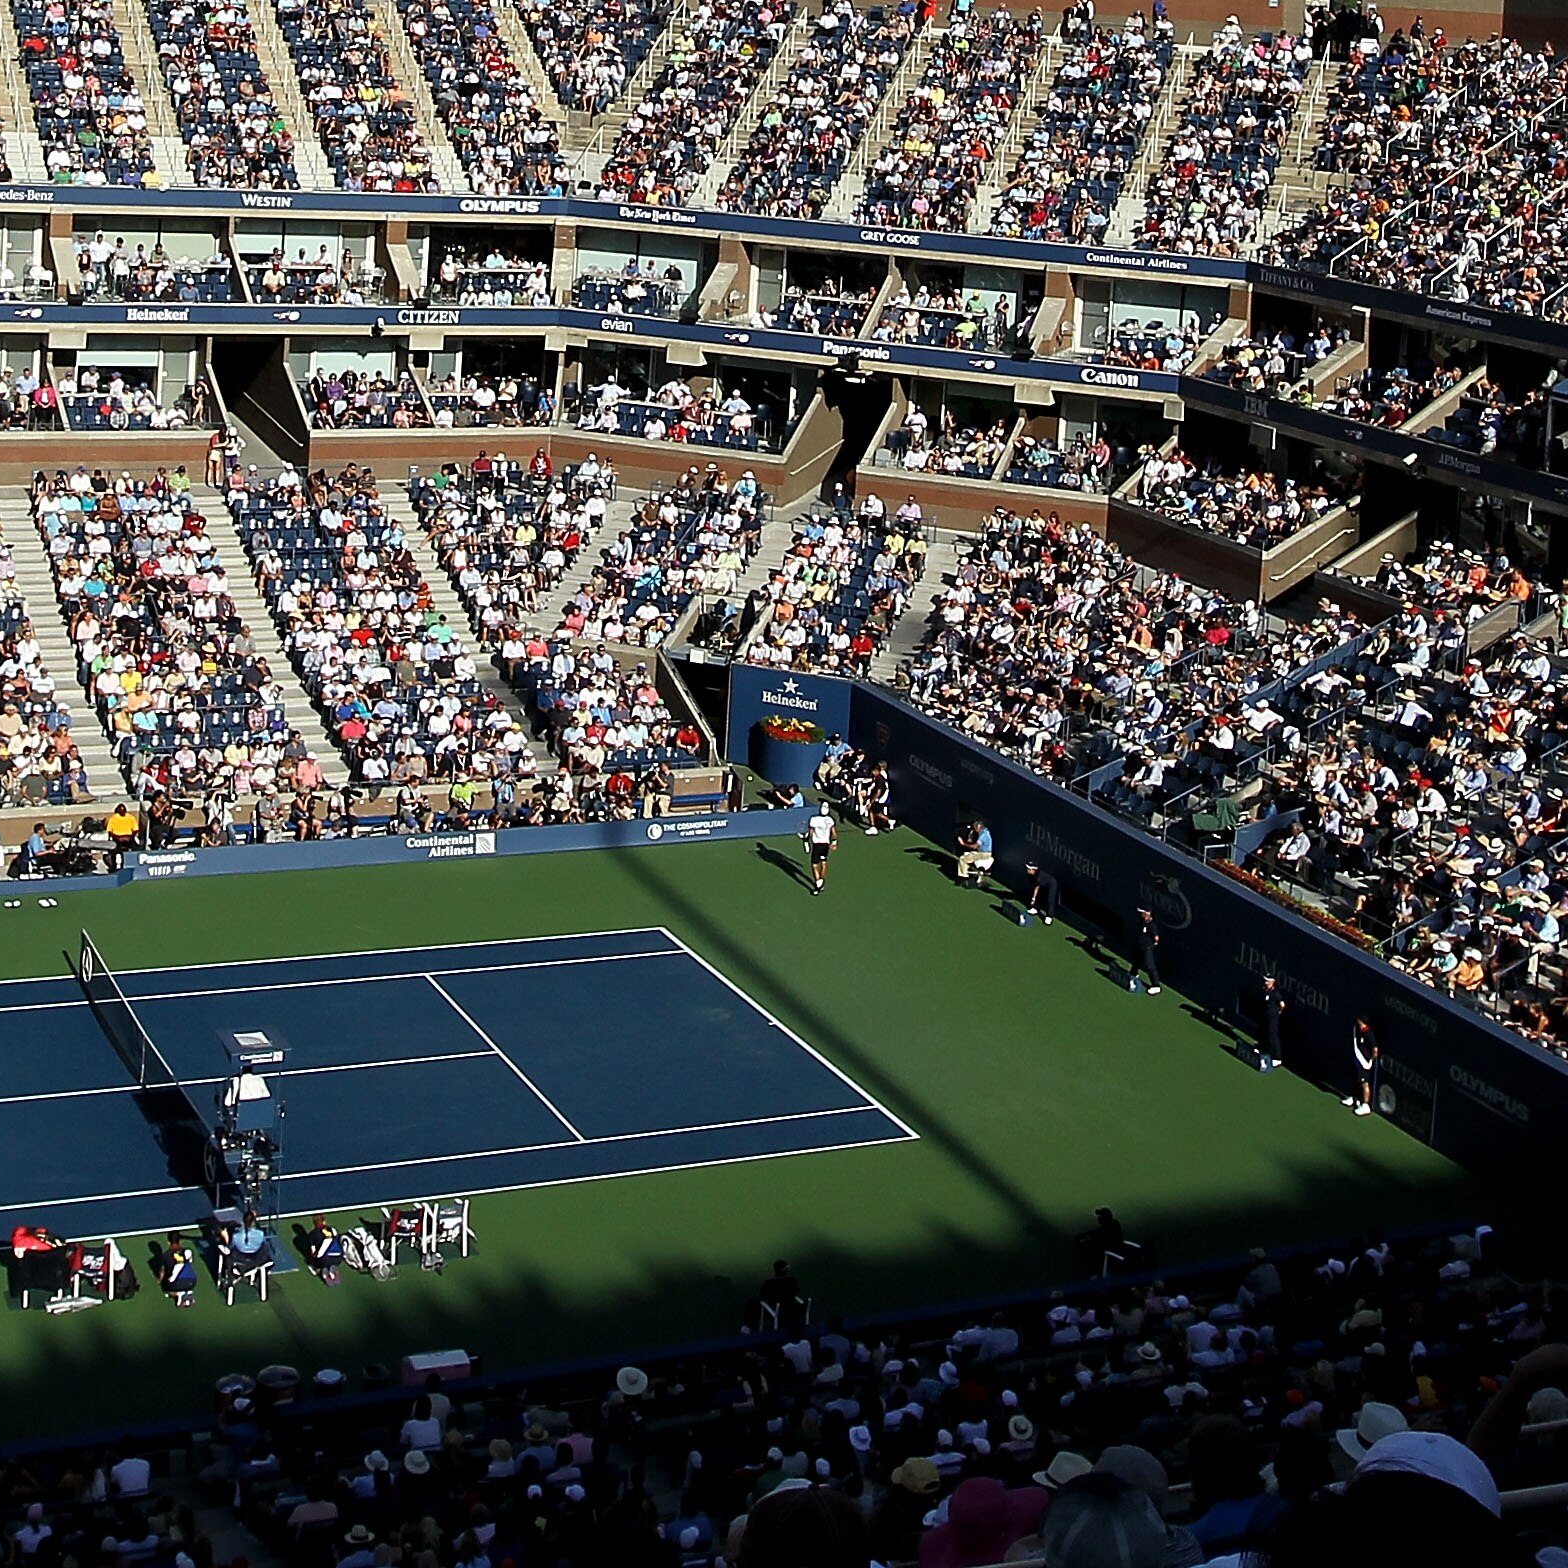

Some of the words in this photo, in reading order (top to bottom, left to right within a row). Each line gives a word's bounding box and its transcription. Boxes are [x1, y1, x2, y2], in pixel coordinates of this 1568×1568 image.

[241, 193, 292, 208] WESTIN
[459, 199, 541, 213] OLYMPUS
[619, 206, 636, 217] The
[635, 208, 652, 219] New
[651, 210, 671, 223] York
[671, 211, 696, 223] Times
[860, 230, 886, 242] GREY
[886, 232, 921, 245] GOOSE
[1085, 252, 1145, 267] Continental
[1147, 258, 1188, 270] Airlines
[126, 308, 190, 322] Heineken
[397, 310, 461, 324] CITIZEN
[1425, 305, 1461, 321] American
[1462, 312, 1492, 327] Express
[601, 317, 633, 333] evian
[1080, 368, 1140, 387] Canon
[762, 690, 818, 711] Heineken
[908, 753, 953, 788] OLYMPUS
[406, 833, 474, 848] Continental
[139, 851, 195, 865] Panasonic
[428, 845, 474, 858] Airlines
[1448, 1064, 1530, 1122] OLYMPUS
